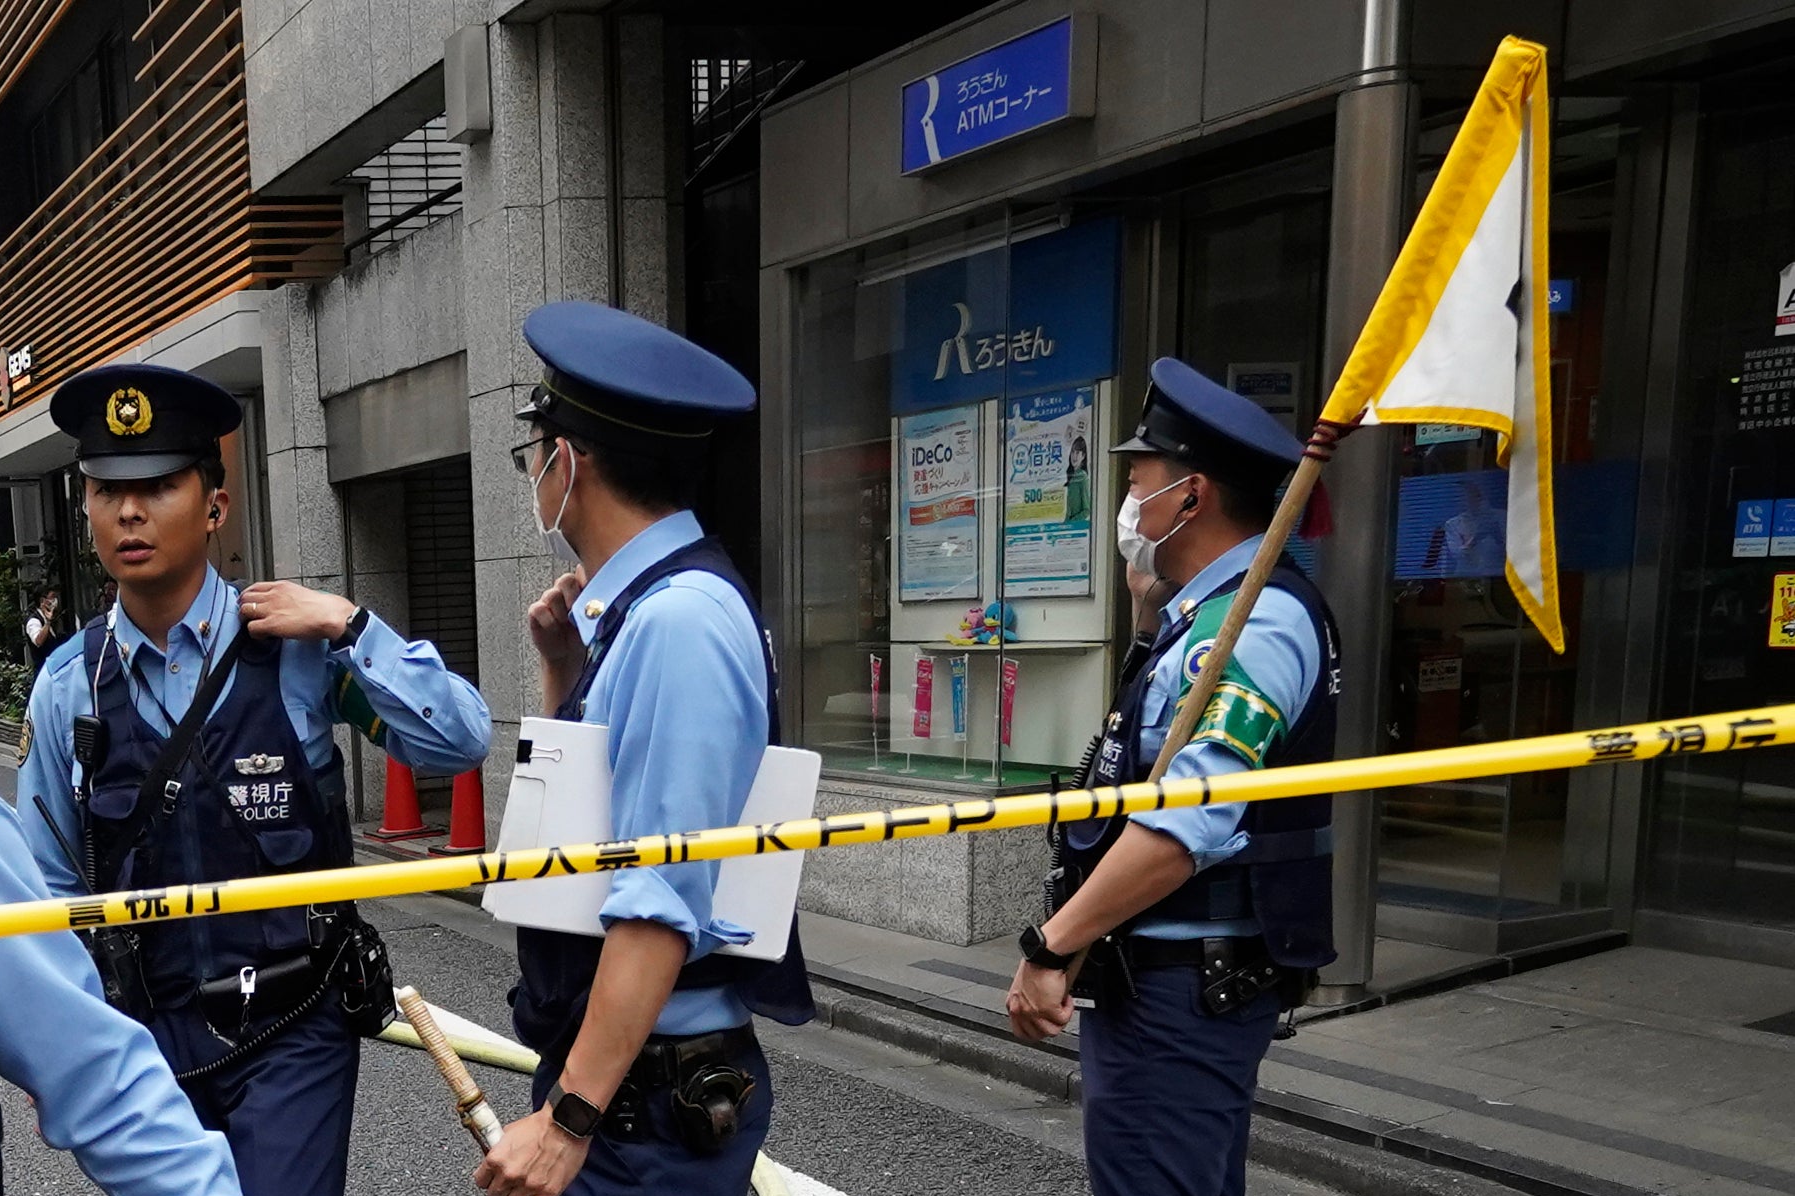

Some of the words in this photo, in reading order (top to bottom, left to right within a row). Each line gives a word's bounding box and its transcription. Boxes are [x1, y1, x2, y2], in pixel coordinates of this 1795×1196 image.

[957, 68, 1008, 104] ろうきん
[957, 85, 1053, 135] ATMコーナー
[8, 345, 32, 379] GEMS
[975, 326, 1055, 370] ろうきん
[912, 443, 953, 467] iDeCo
[1028, 441, 1063, 467] 借換
[1024, 488, 1043, 504] 500
[227, 781, 293, 806] 警視庁
